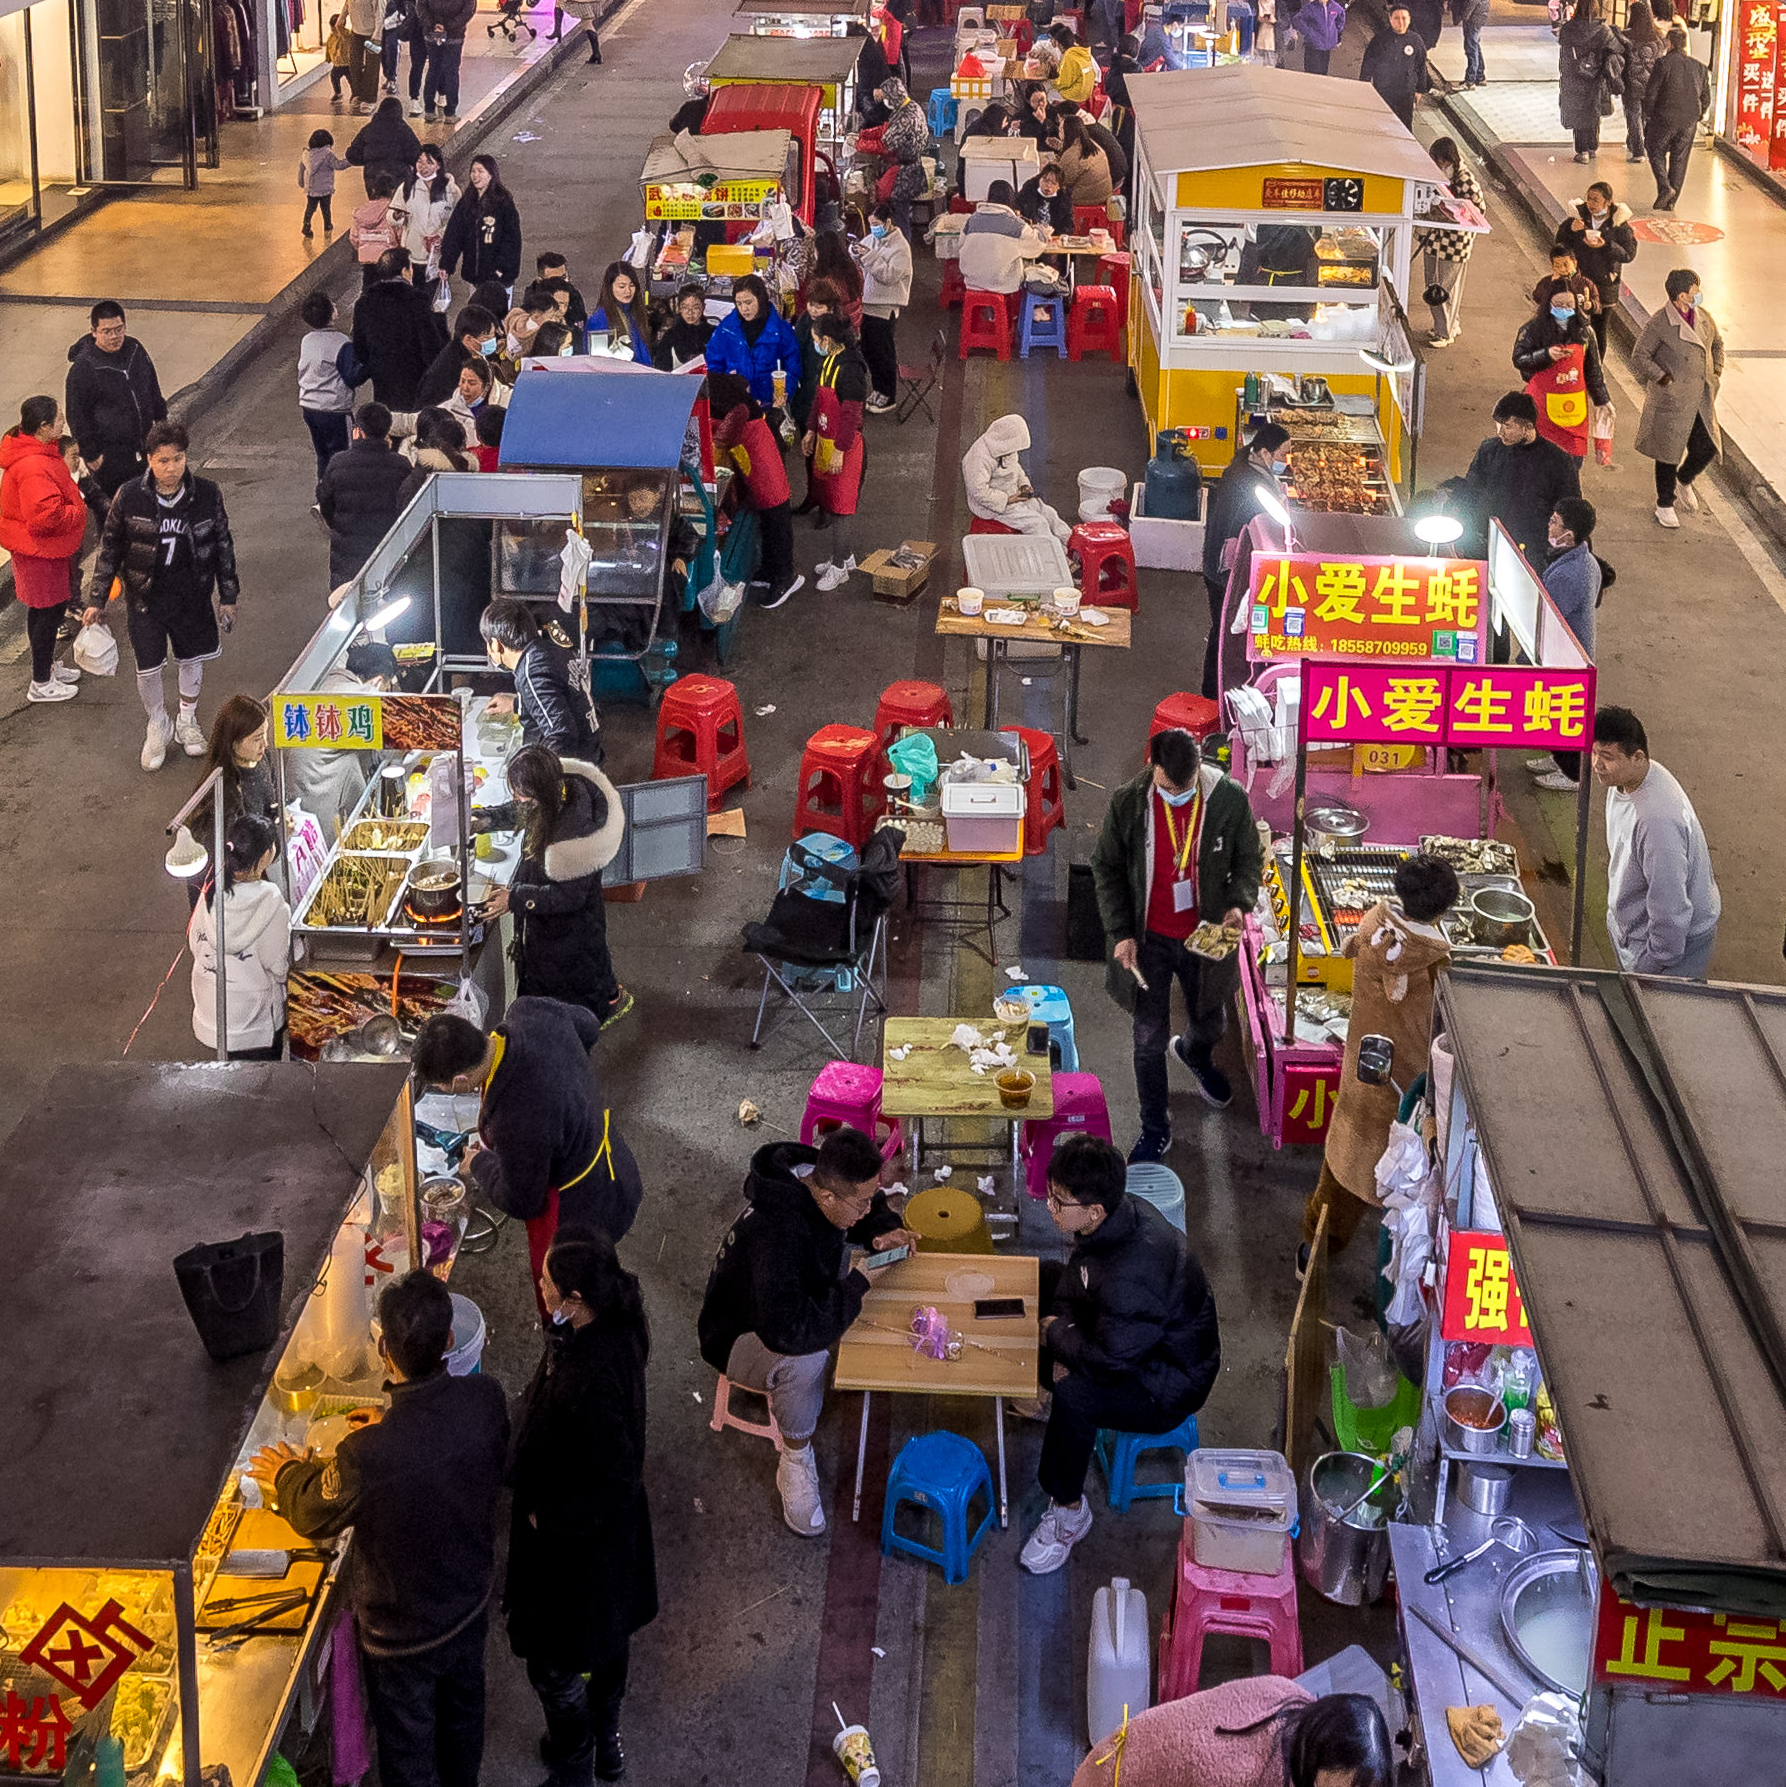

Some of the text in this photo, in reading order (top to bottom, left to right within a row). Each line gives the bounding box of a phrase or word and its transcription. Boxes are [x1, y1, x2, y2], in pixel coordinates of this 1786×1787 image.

[161, 537, 177, 567] 7
[1257, 560, 1479, 629] 小爱生蚝
[1331, 639, 1428, 656] 18558709959
[284, 703, 374, 742] 钵钵鸡
[1311, 676, 1586, 739] 小爱生蚝
[1369, 751, 1400, 765] 031
